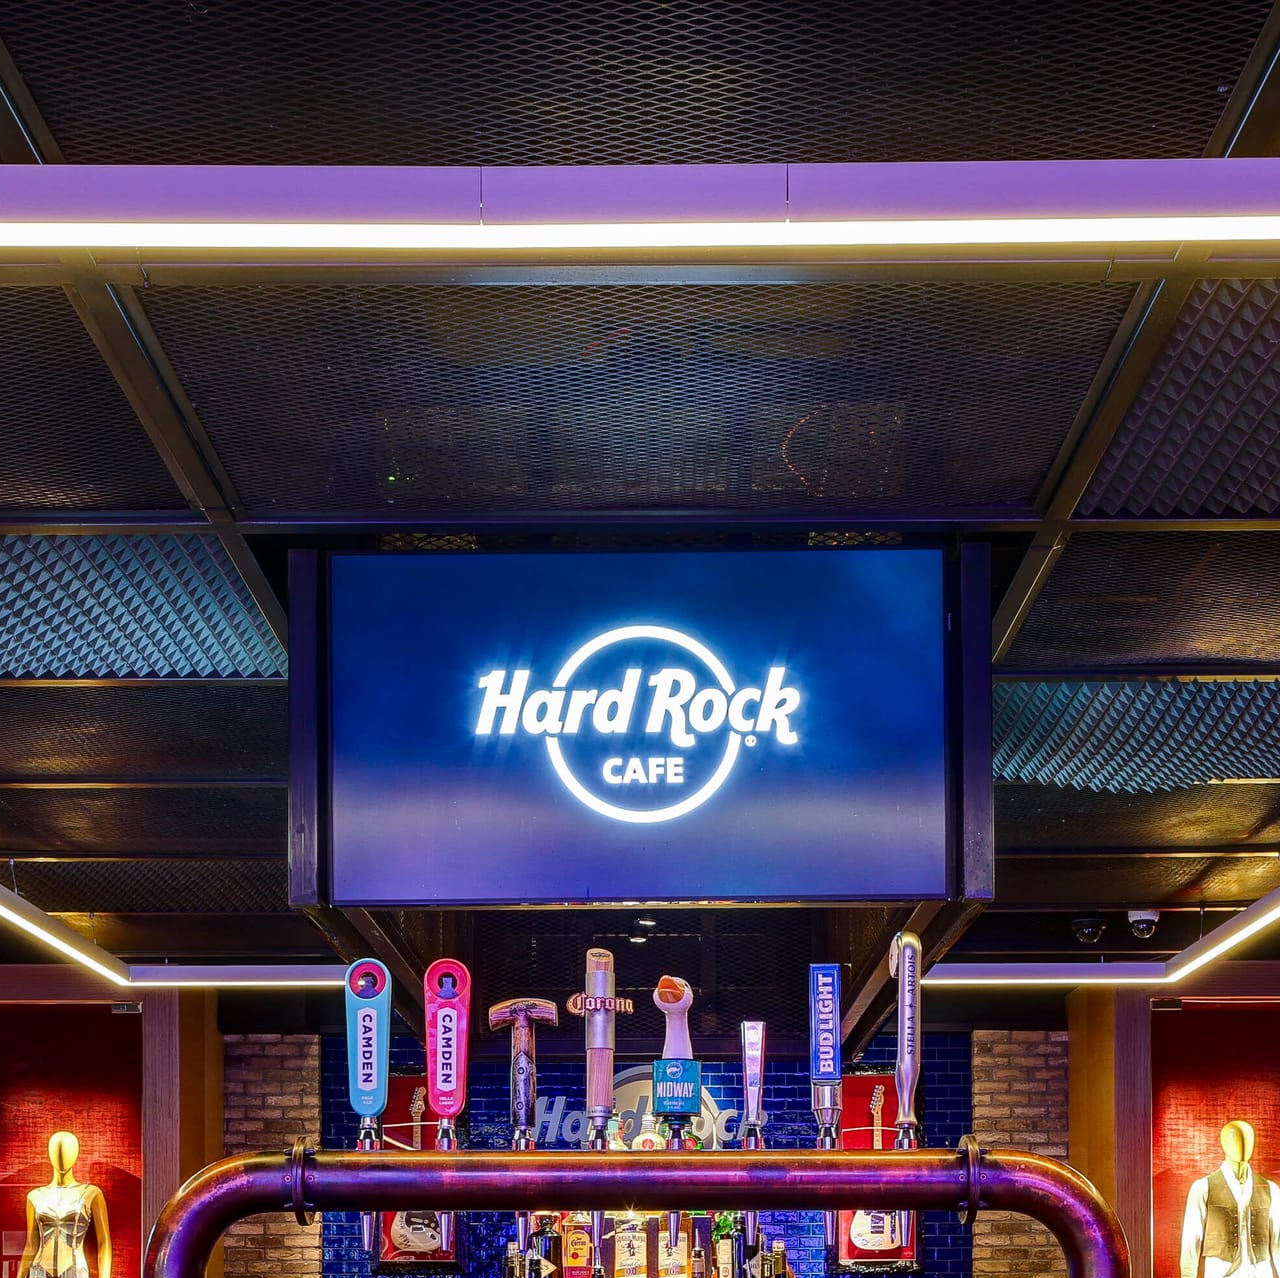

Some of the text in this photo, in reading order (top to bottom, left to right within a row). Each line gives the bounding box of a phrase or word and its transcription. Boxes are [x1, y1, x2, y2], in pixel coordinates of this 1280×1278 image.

[475, 667, 801, 747] Hard Rock
[603, 757, 684, 784] CAFE
[566, 991, 634, 1017] Corona
[818, 974, 834, 1073] BUD LIGHT
[907, 954, 915, 1055] STELLA ARTOIS
[362, 1013, 373, 1084] CAMDEN
[442, 1013, 453, 1084] CAMDEN
[531, 1095, 649, 1143] Had
[656, 1081, 694, 1098] MIDWAY
